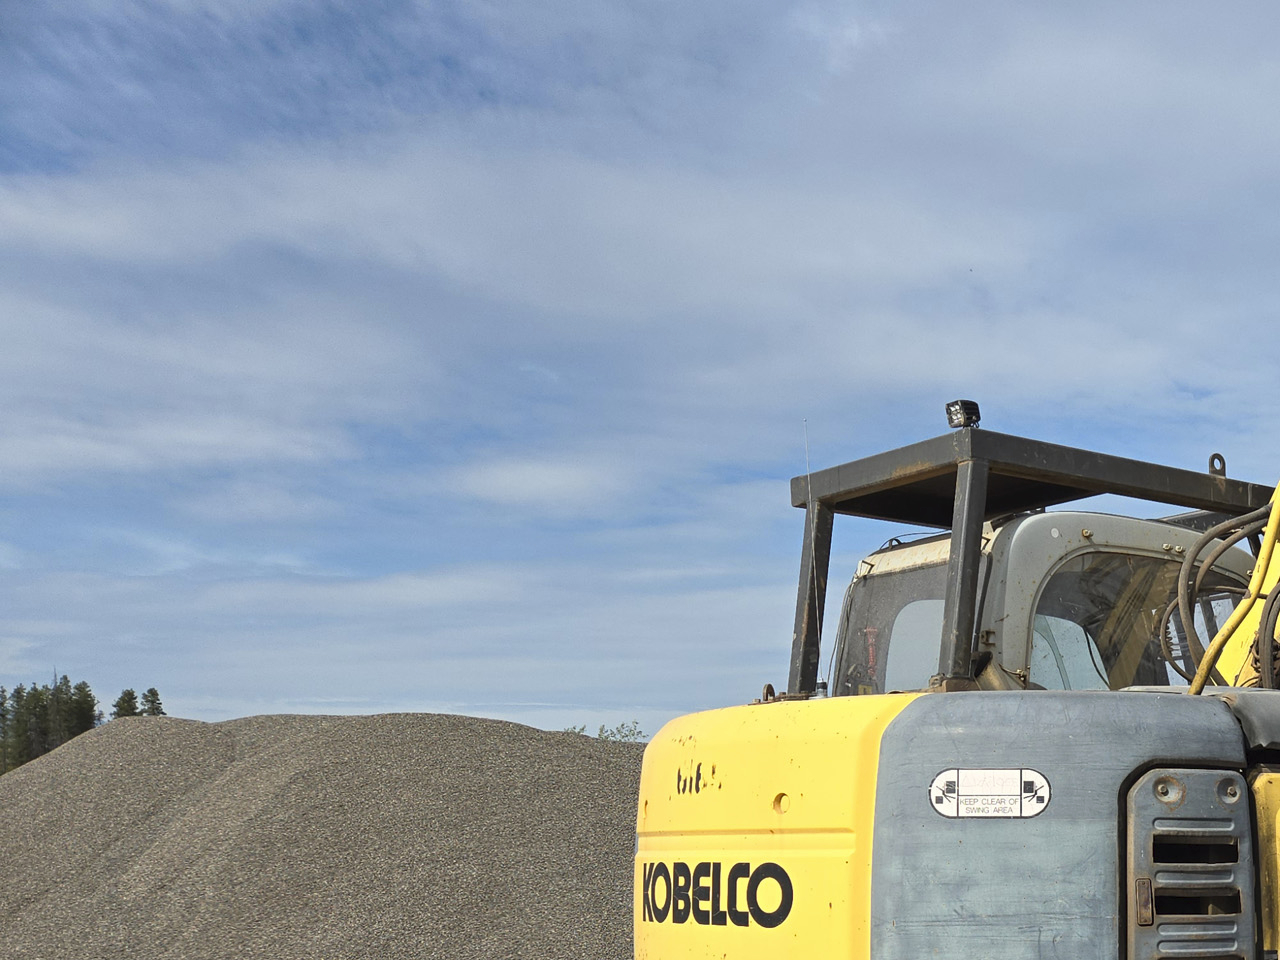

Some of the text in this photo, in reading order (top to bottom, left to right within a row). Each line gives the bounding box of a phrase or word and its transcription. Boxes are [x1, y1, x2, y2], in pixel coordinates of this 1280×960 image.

[959, 798, 1019, 806] KEEP CLEAR OF
[965, 806, 1013, 814] SWING AREA
[643, 861, 794, 929] KOBELCO
